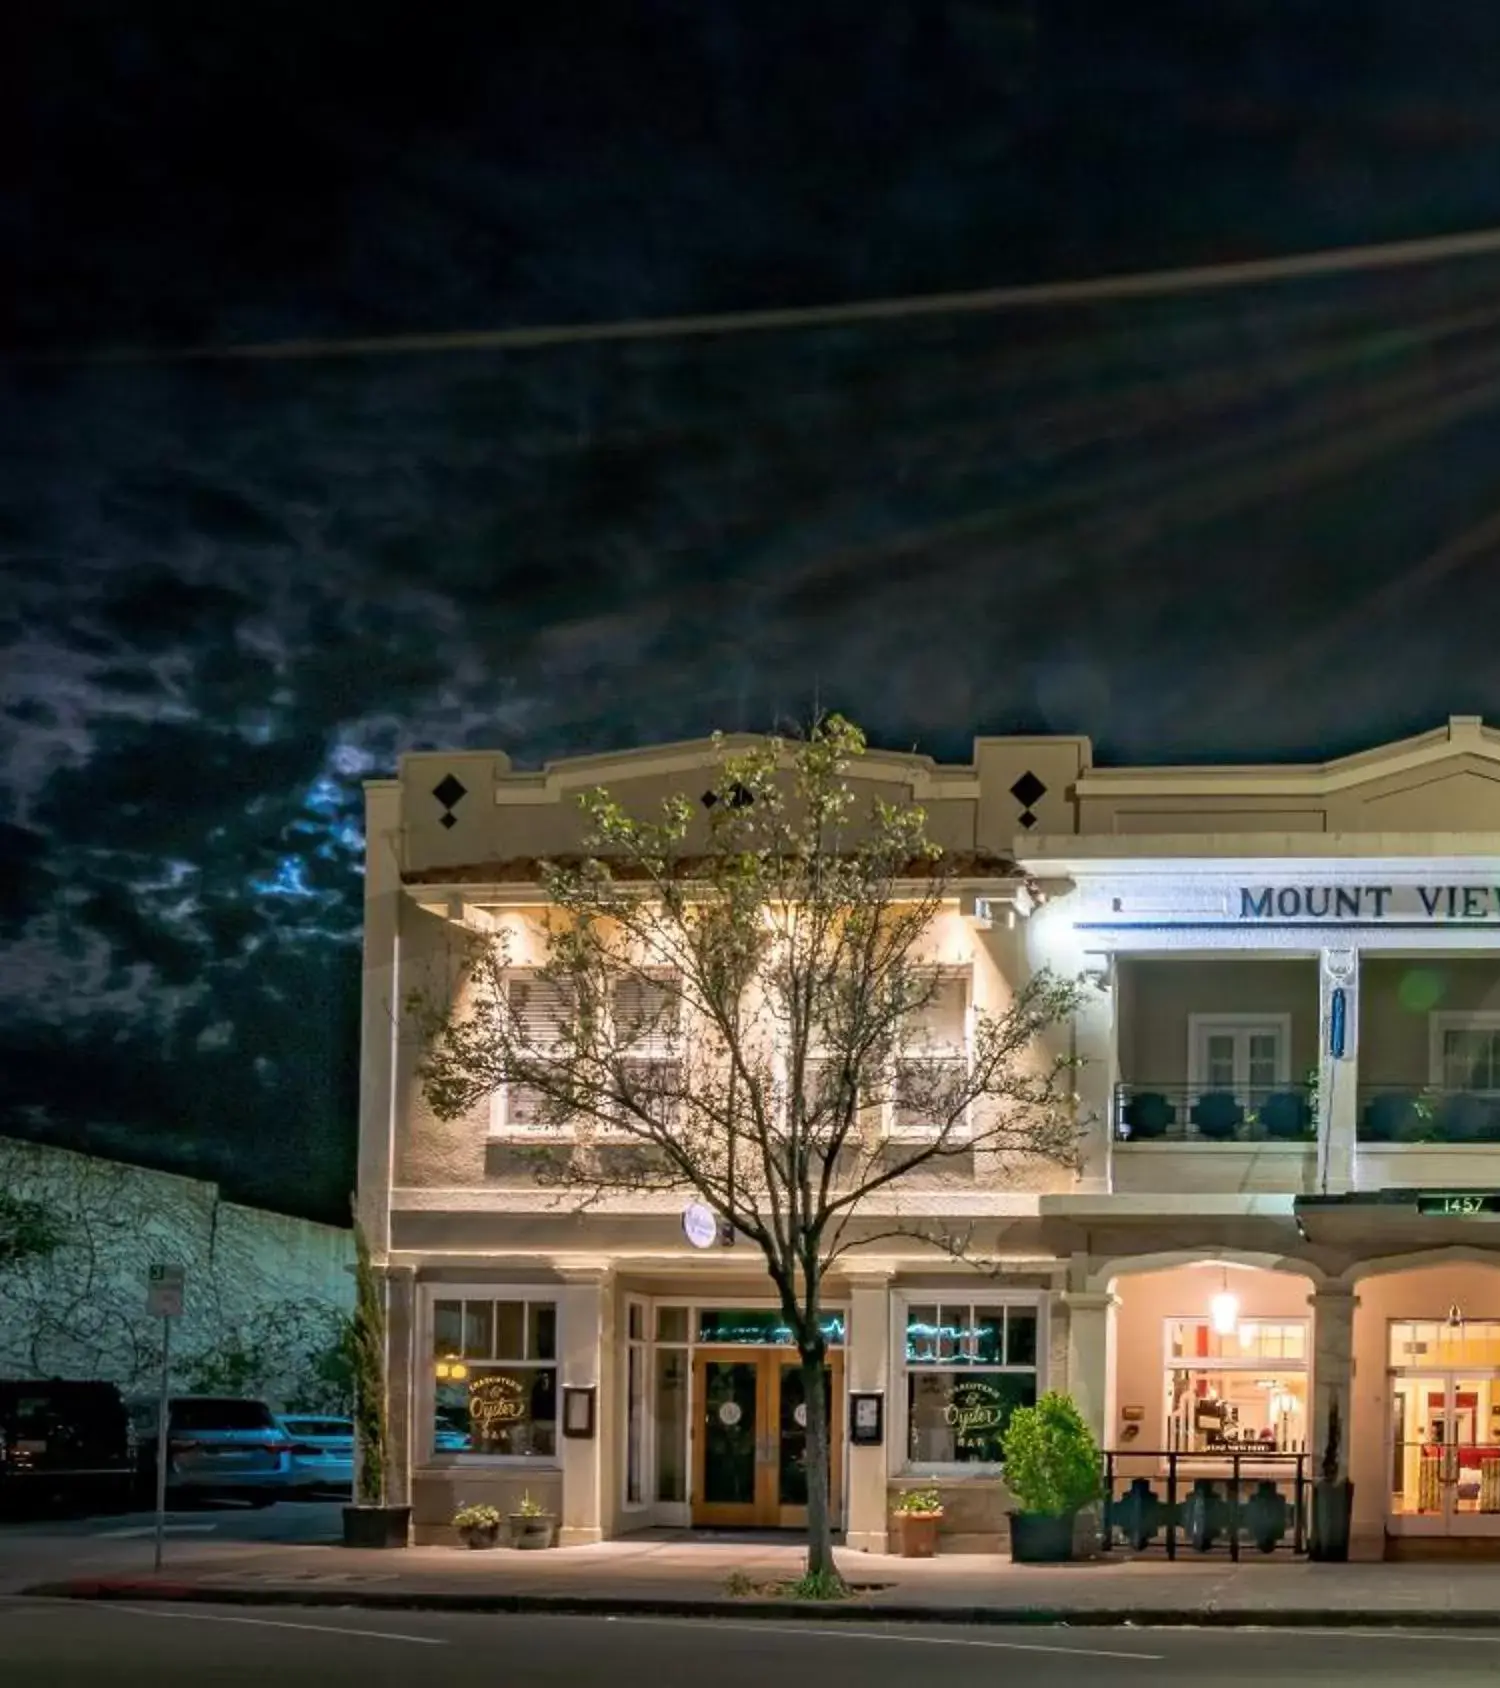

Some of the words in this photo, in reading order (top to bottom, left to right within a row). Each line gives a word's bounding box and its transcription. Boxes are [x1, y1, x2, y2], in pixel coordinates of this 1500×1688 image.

[1240, 886, 1393, 918] MOUNT
[1444, 1197, 1486, 1214] 1457
[469, 1397, 525, 1431] Oyster
[943, 1403, 1002, 1436] Oyster
[958, 1437, 985, 1447] BAR
